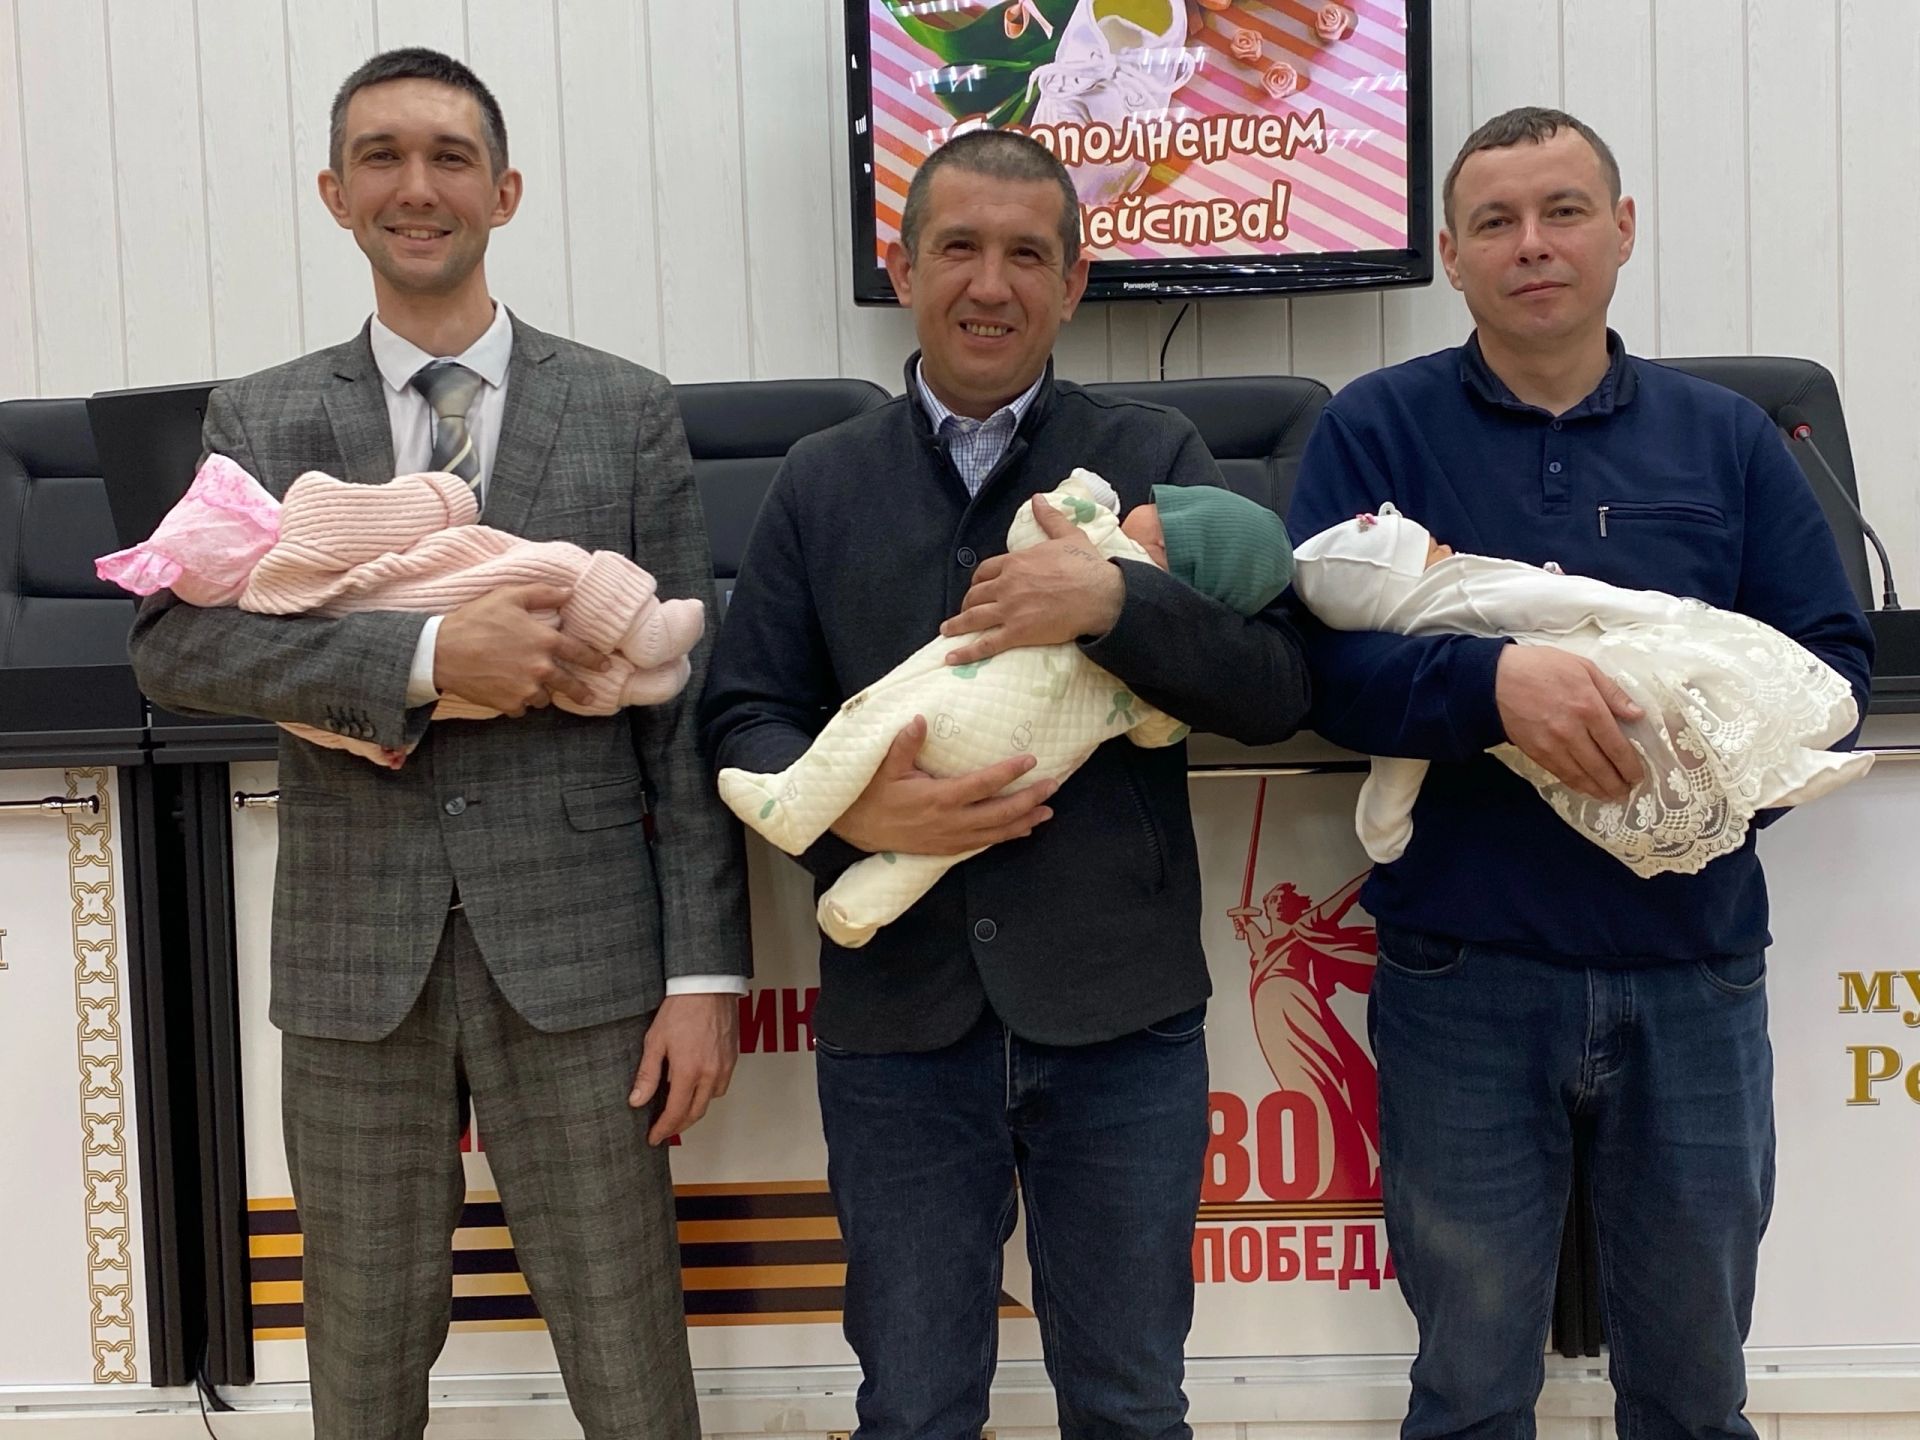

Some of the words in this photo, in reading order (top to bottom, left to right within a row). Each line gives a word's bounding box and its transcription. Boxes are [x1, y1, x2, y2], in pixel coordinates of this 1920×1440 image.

[1001, 107, 1328, 167] ополнением
[1081, 179, 1292, 249] ейства!
[1200, 1089, 1320, 1202] 80
[1191, 1224, 1397, 1290] ПОБЕД
